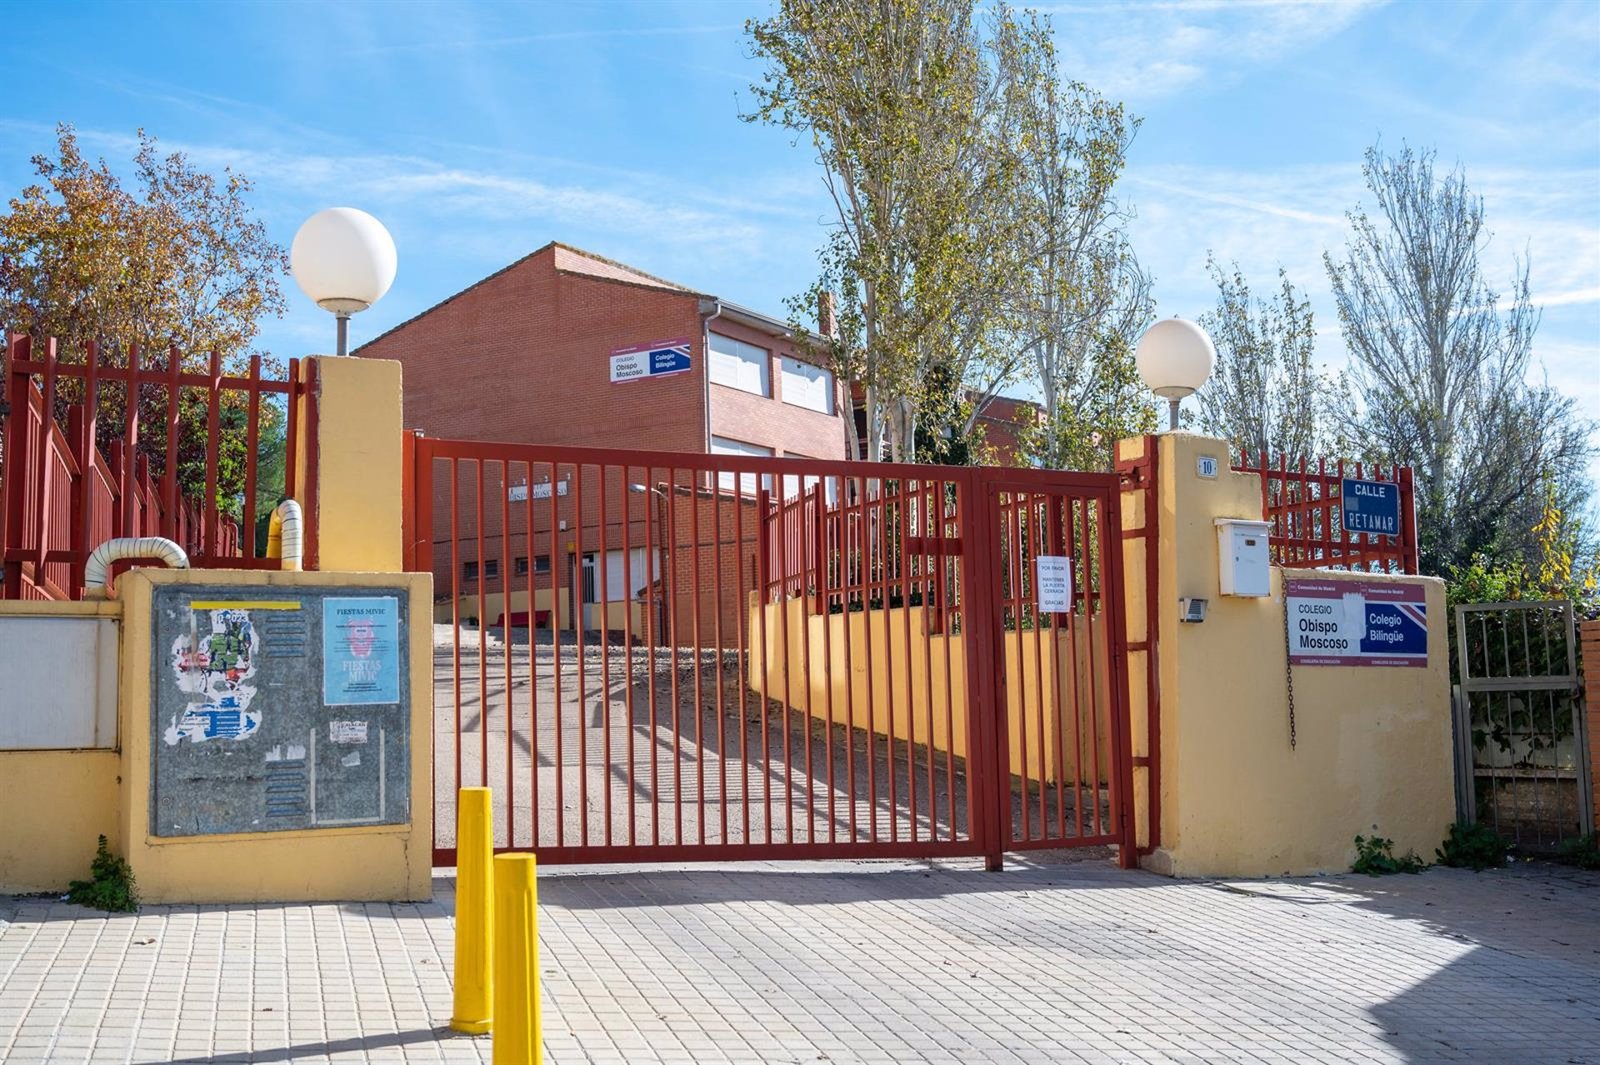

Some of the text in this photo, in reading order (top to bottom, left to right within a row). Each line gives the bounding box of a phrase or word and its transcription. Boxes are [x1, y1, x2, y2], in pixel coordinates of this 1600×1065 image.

[655, 353, 675, 361] Colegio
[616, 362, 638, 371] Obispo
[616, 369, 643, 378] Moscoso
[1203, 461, 1212, 474] 10
[1354, 484, 1386, 498] CALLE
[1348, 512, 1394, 531] RETAMAR
[1299, 604, 1332, 614] COLEGIO
[1369, 613, 1402, 627] Colegio
[1299, 619, 1338, 635] Obispo
[1300, 635, 1348, 649] Moscoso
[1370, 629, 1404, 643] Bilingüe
[343, 660, 382, 671] FIESTAS
[349, 671, 378, 682] MIVIC
